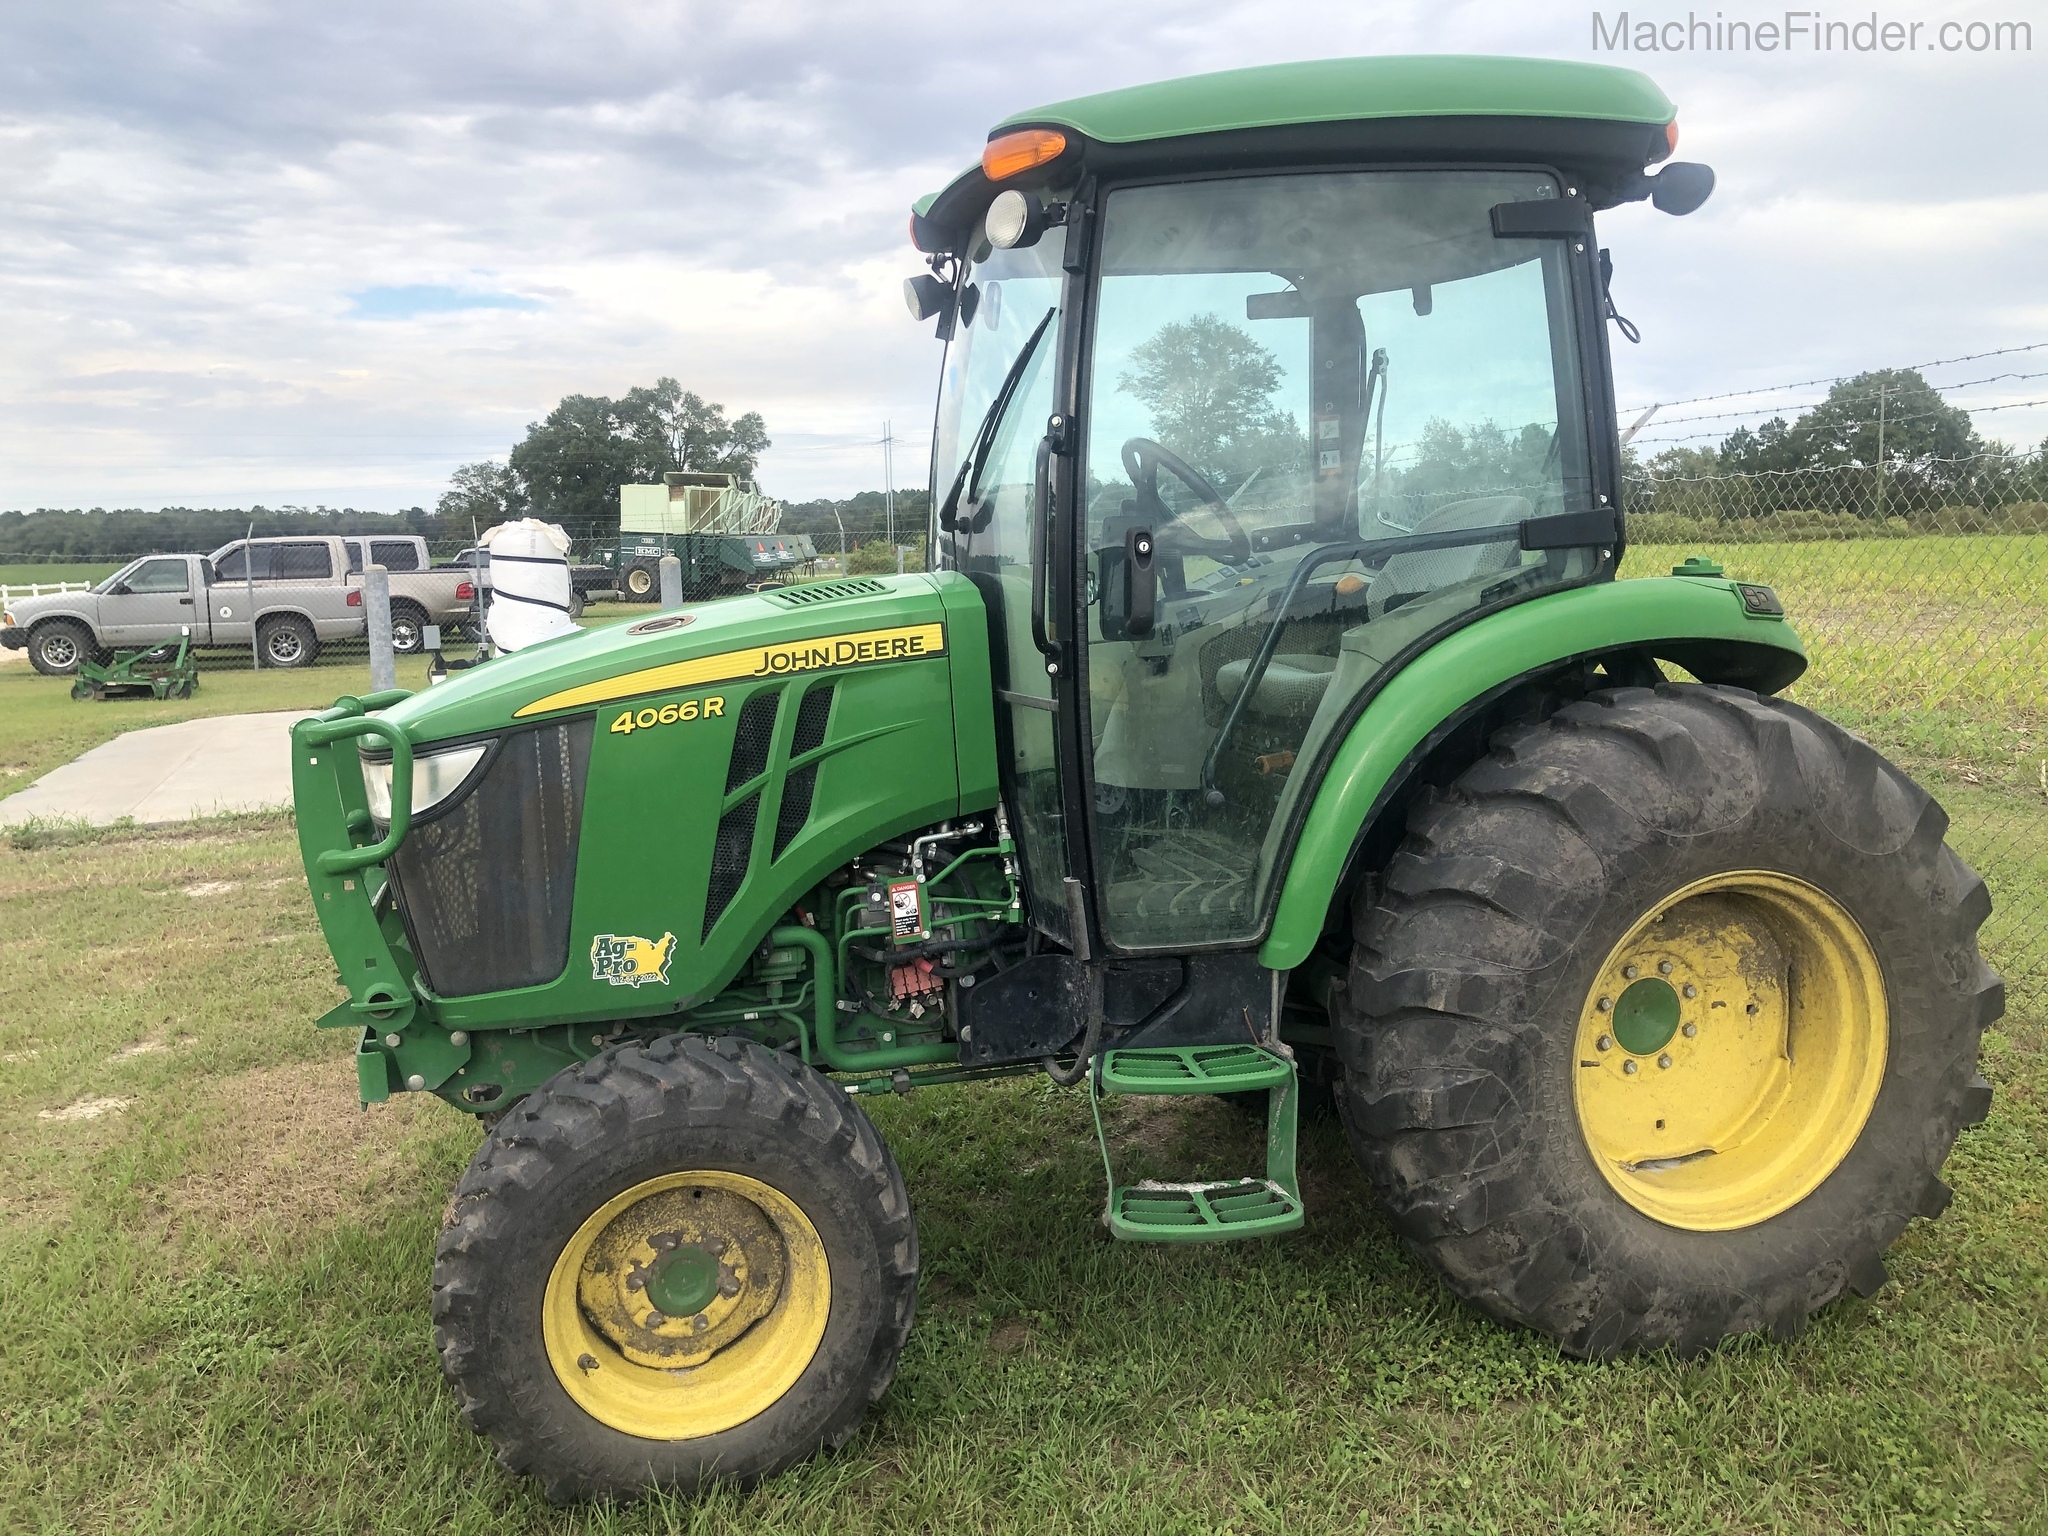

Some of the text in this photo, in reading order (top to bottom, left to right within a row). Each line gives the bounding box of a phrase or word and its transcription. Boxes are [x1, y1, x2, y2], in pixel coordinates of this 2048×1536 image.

[754, 635, 925, 674] JOHN DEERE
[595, 937, 635, 959] Ag-
[597, 958, 637, 976] Pro
